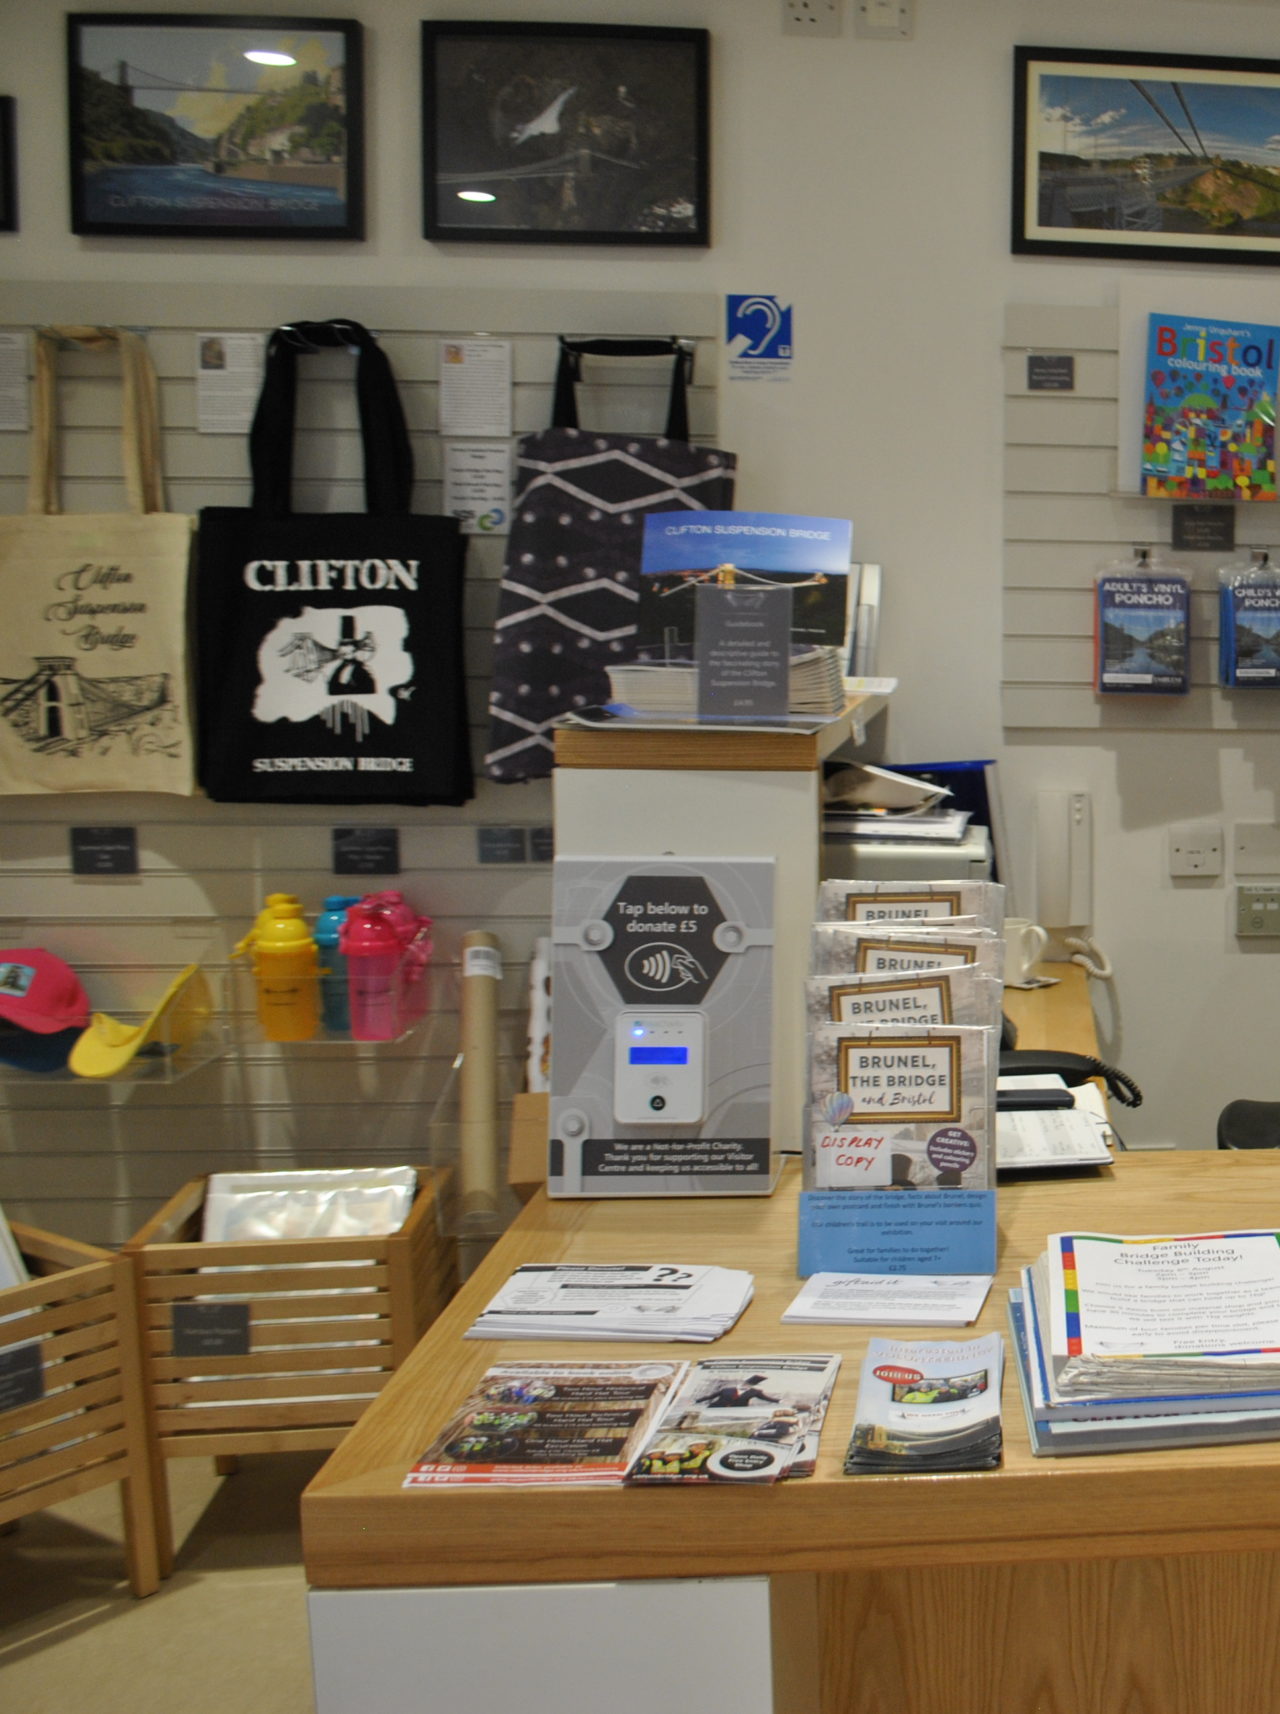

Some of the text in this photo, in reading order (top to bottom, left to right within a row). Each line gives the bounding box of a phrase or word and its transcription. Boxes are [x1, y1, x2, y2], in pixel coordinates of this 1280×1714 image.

[1157, 325, 1275, 370] Bristol
[1167, 357, 1263, 378] colouring book
[665, 524, 832, 541] CLIFTON SUSPENSION BRIDGE
[55, 563, 134, 592] Clifton
[243, 559, 421, 592] CLIFTON
[1104, 582, 1185, 594] ADULT'S VINYL
[1234, 588, 1273, 598] CHILD'S
[1114, 593, 1174, 605] PONCHO
[725, 619, 764, 628] Guidebook
[727, 639, 756, 648] detailed
[757, 640, 771, 648] and
[743, 668, 768, 677] Clifton
[252, 757, 415, 773] SUSPENSION BRIDGE
[617, 901, 709, 917] Tap below to
[626, 920, 698, 933] donate £5
[851, 996, 928, 1015] BRUNEL,
[859, 1055, 937, 1070] BRUNEL,
[850, 1074, 947, 1087] THE BRIDGE
[861, 1090, 936, 1107] and Bristol
[947, 1130, 962, 1138] GET
[613, 1142, 629, 1151] We
[630, 1143, 645, 1151] are
[652, 1142, 711, 1151] Not-for-Profit
[820, 1135, 885, 1149] DISPLAY
[604, 1152, 630, 1162] Thank
[631, 1154, 647, 1163] you
[649, 1153, 662, 1161] for
[663, 1153, 709, 1163] supporting
[726, 1152, 755, 1161] Visitor
[835, 1153, 877, 1172] COPY
[598, 1163, 627, 1172] Centre
[628, 1163, 644, 1172] and
[646, 1163, 680, 1174] keeping
[692, 1163, 734, 1172] accessible
[735, 1163, 745, 1171] to
[808, 1194, 836, 1202] Discover
[847, 1194, 864, 1202] story
[873, 1193, 884, 1201] the
[907, 1192, 922, 1201] facts
[924, 1192, 942, 1200] about
[966, 1192, 988, 1202] design
[842, 1202, 869, 1211] postcard
[870, 1202, 883, 1210] and
[902, 1201, 916, 1209] with
[917, 1201, 942, 1209] Brunel's
[847, 1246, 865, 1255] Great
[877, 1246, 902, 1254] families
[920, 1245, 949, 1255] together!
[1153, 1242, 1199, 1251] Family
[853, 1255, 879, 1263] Suitable
[891, 1255, 916, 1263] children
[917, 1255, 933, 1264] aged
[1119, 1248, 1236, 1260] Bridge Building
[1113, 1254, 1244, 1267] Challenge Today!
[729, 1453, 768, 1462] Open Daily
